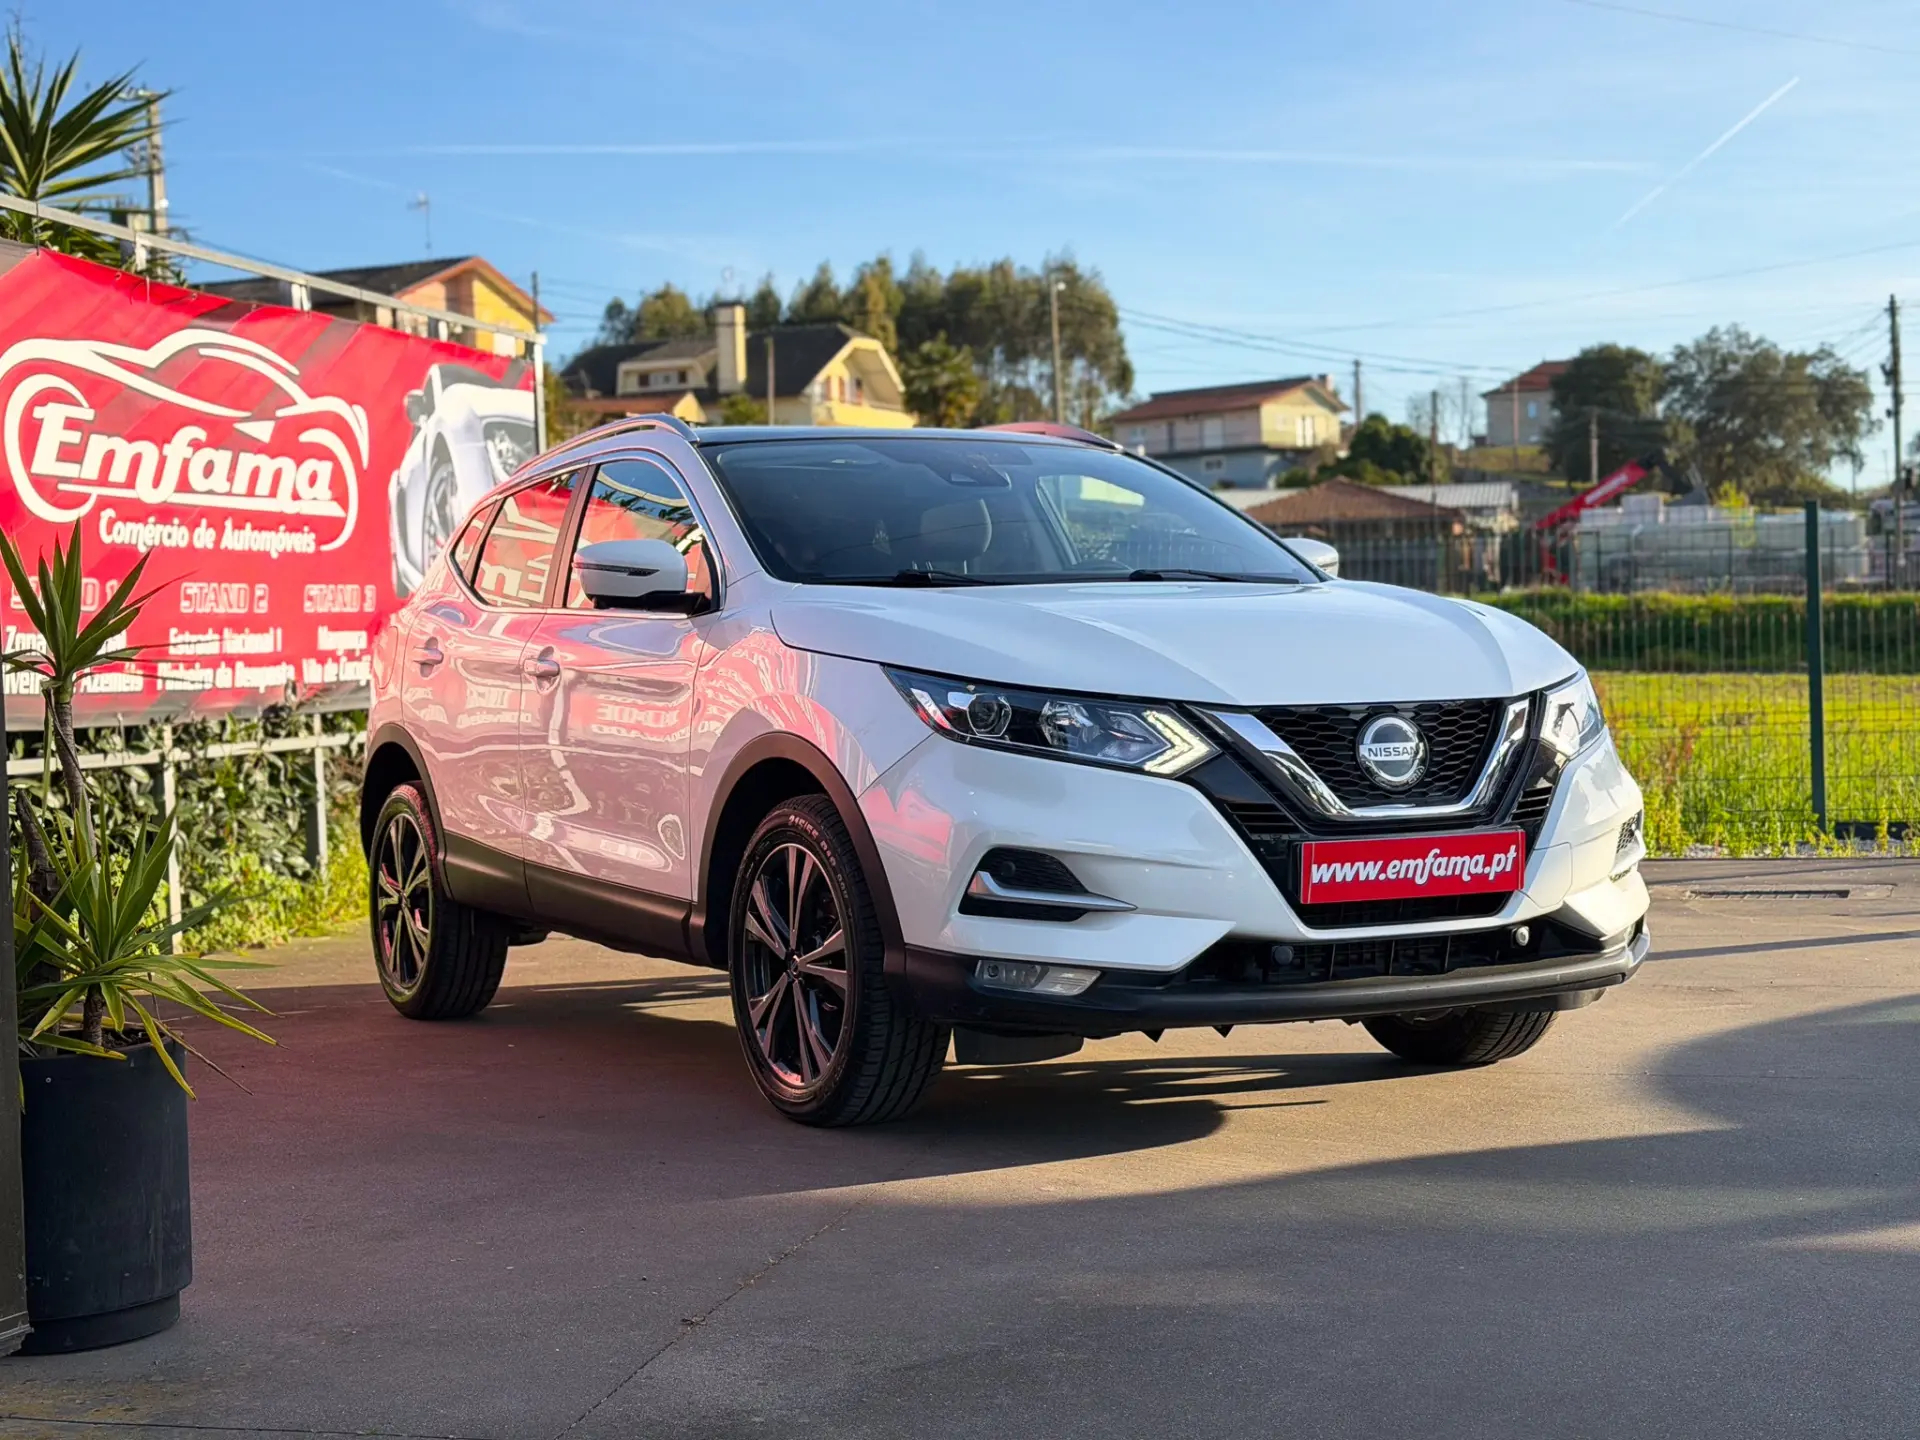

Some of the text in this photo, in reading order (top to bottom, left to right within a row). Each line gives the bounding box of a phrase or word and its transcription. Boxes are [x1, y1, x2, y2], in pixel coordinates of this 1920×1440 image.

[31, 403, 335, 513] Emfama
[99, 508, 316, 559] Comércio de Automóveis
[180, 583, 269, 613] STAND 2
[304, 584, 376, 613] STAND 3
[1367, 746, 1418, 759] NISSAN
[1311, 845, 1517, 886] www.emfama.pt
